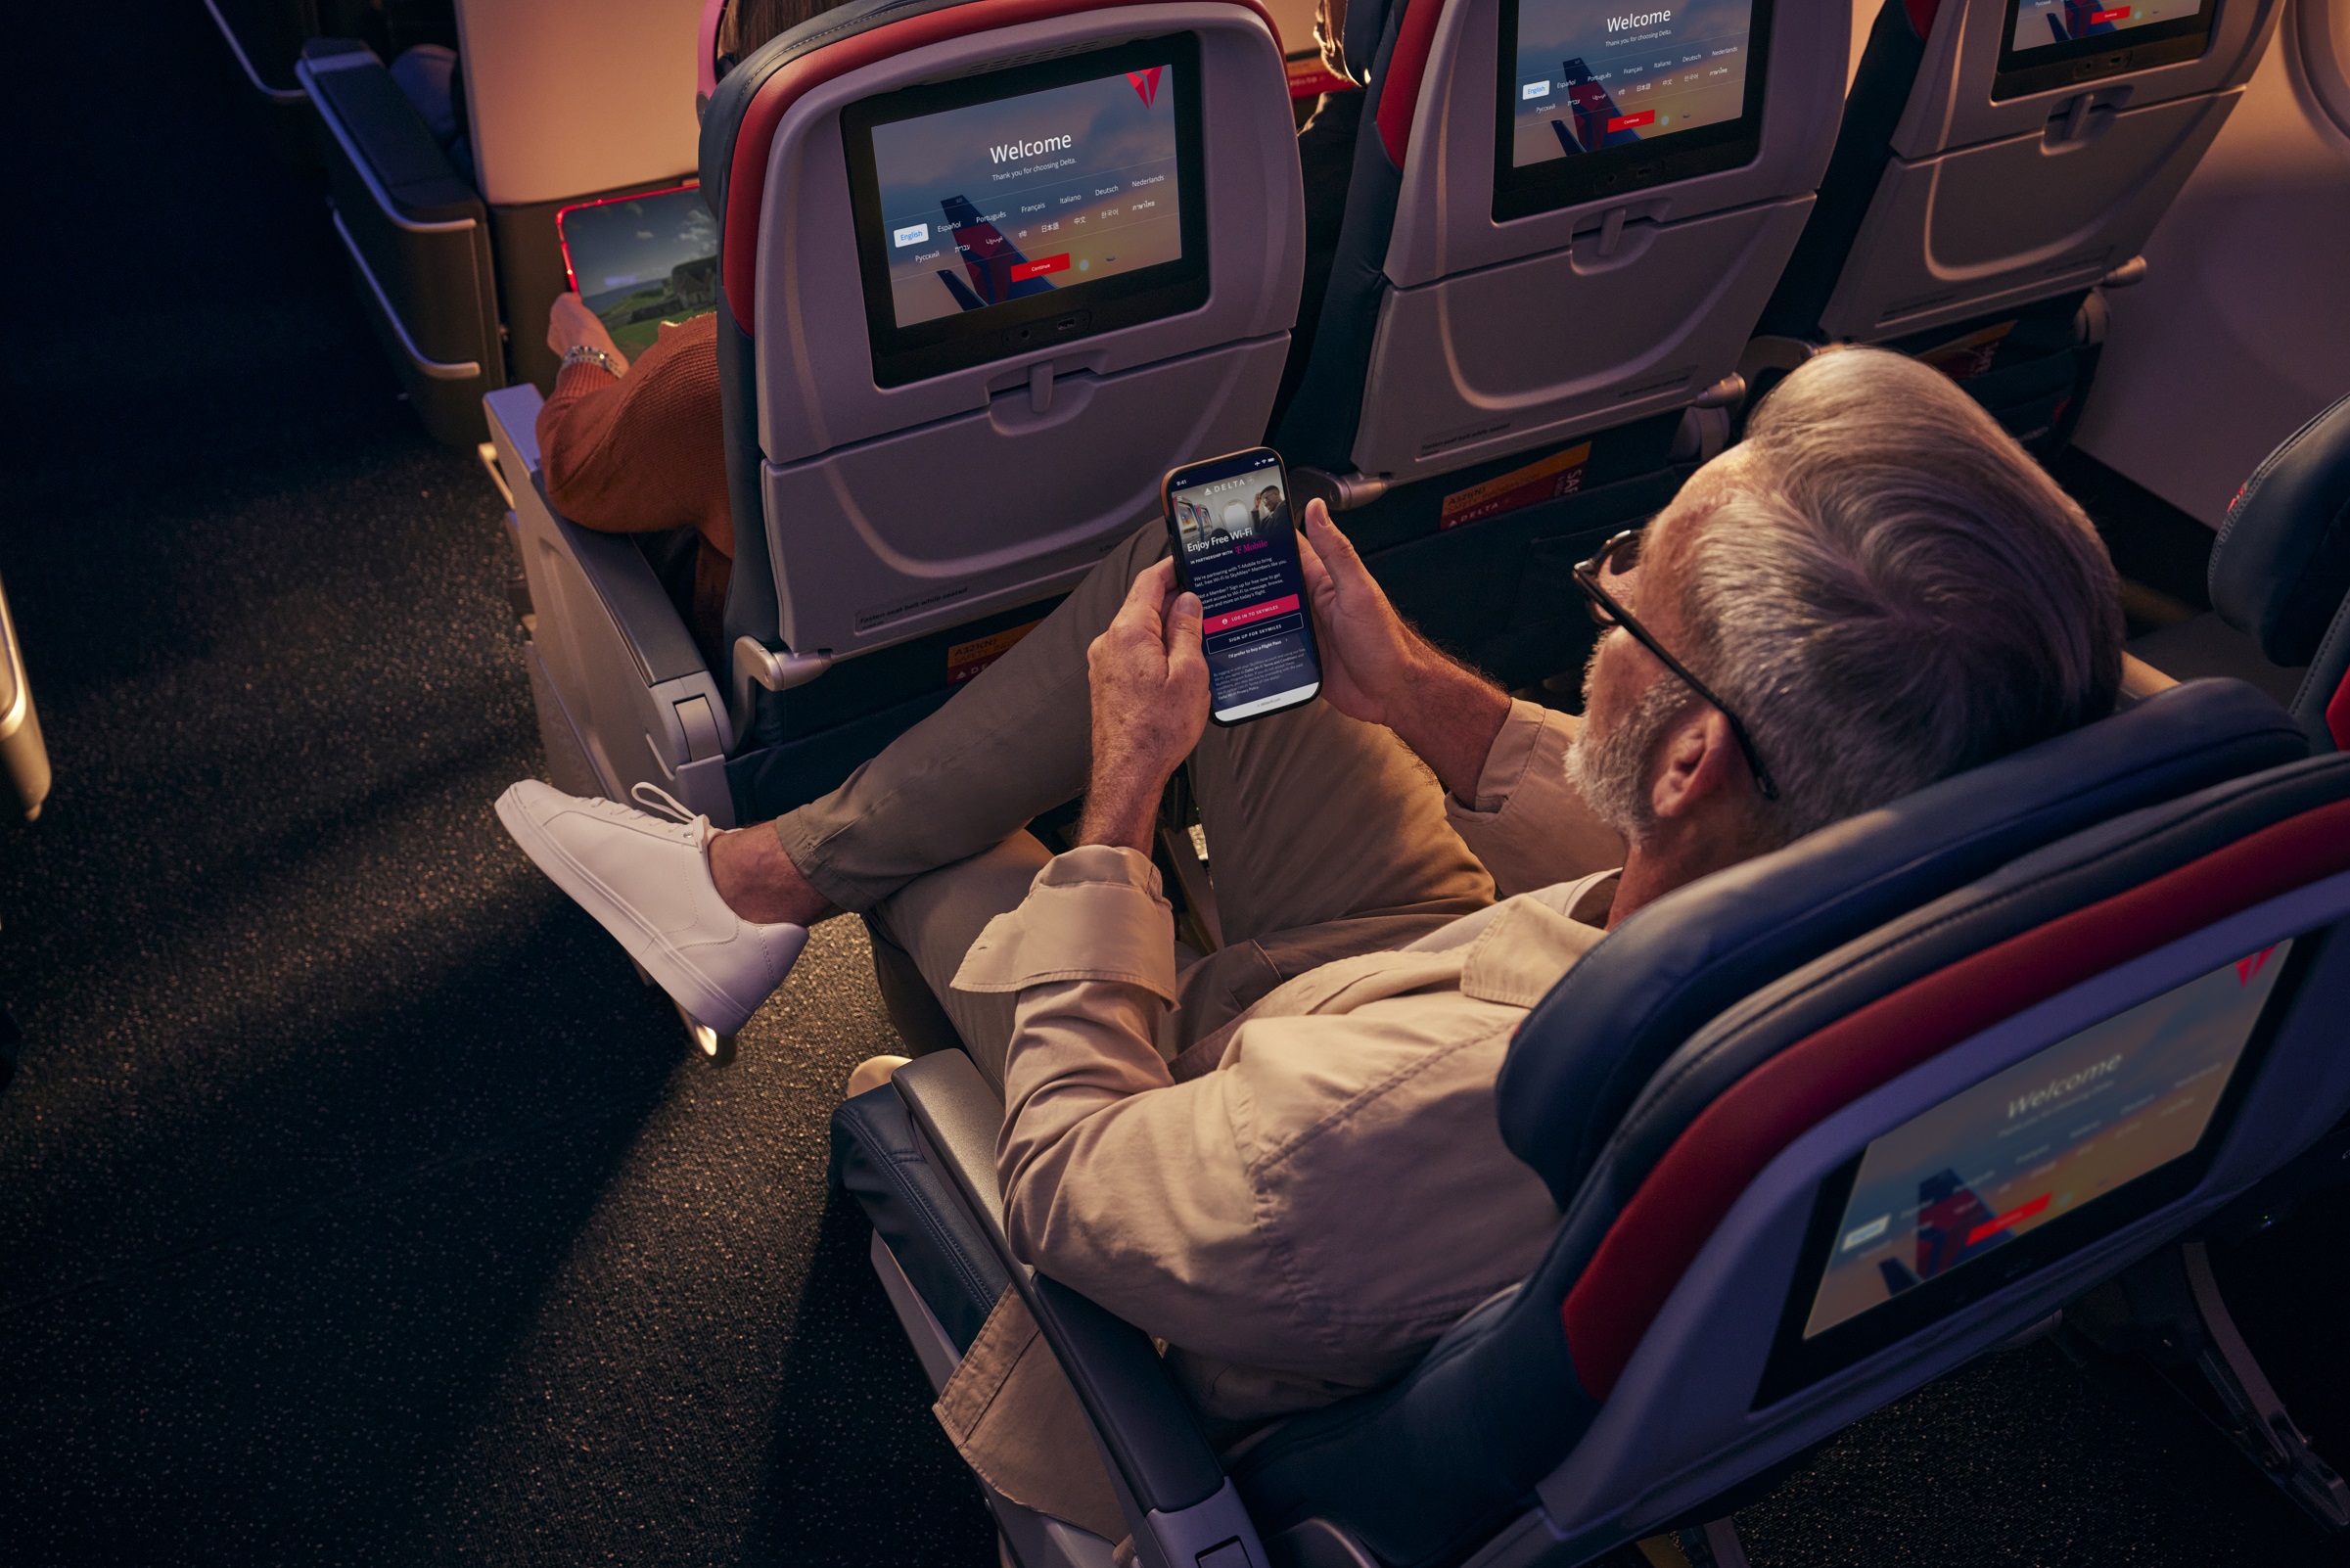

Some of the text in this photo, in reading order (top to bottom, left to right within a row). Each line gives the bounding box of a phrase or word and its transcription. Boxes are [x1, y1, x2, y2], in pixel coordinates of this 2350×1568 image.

[1608, 10, 1670, 32] Welcome
[991, 135, 1071, 163] Welcome
[992, 172, 1010, 180] Thank
[1011, 171, 1022, 179] you
[1033, 162, 1059, 172] choosing
[1132, 175, 1164, 187] Nederlands
[1095, 186, 1118, 196] Deutsch
[1060, 195, 1081, 203] Italiano
[1021, 203, 1045, 212] Français
[976, 211, 1006, 222] Português
[1101, 209, 1118, 219] 한국어
[937, 221, 960, 232] Español
[1042, 222, 1059, 232] 日本語
[900, 231, 922, 241] English
[915, 251, 940, 263] Русский
[1214, 480, 1245, 492] DELTA
[1460, 503, 1499, 522] DELTA
[1187, 527, 1252, 552] Enjoy Free Wi-Fi
[1243, 540, 1268, 552] Mobile
[1196, 553, 1221, 563] PARTNERSHIP
[1207, 570, 1228, 579] partnering
[1209, 587, 1229, 595] Member?
[1256, 605, 1278, 614] SKYMILES
[1259, 624, 1281, 634] SKYMILES
[2006, 1052, 2123, 1119] Welcome
